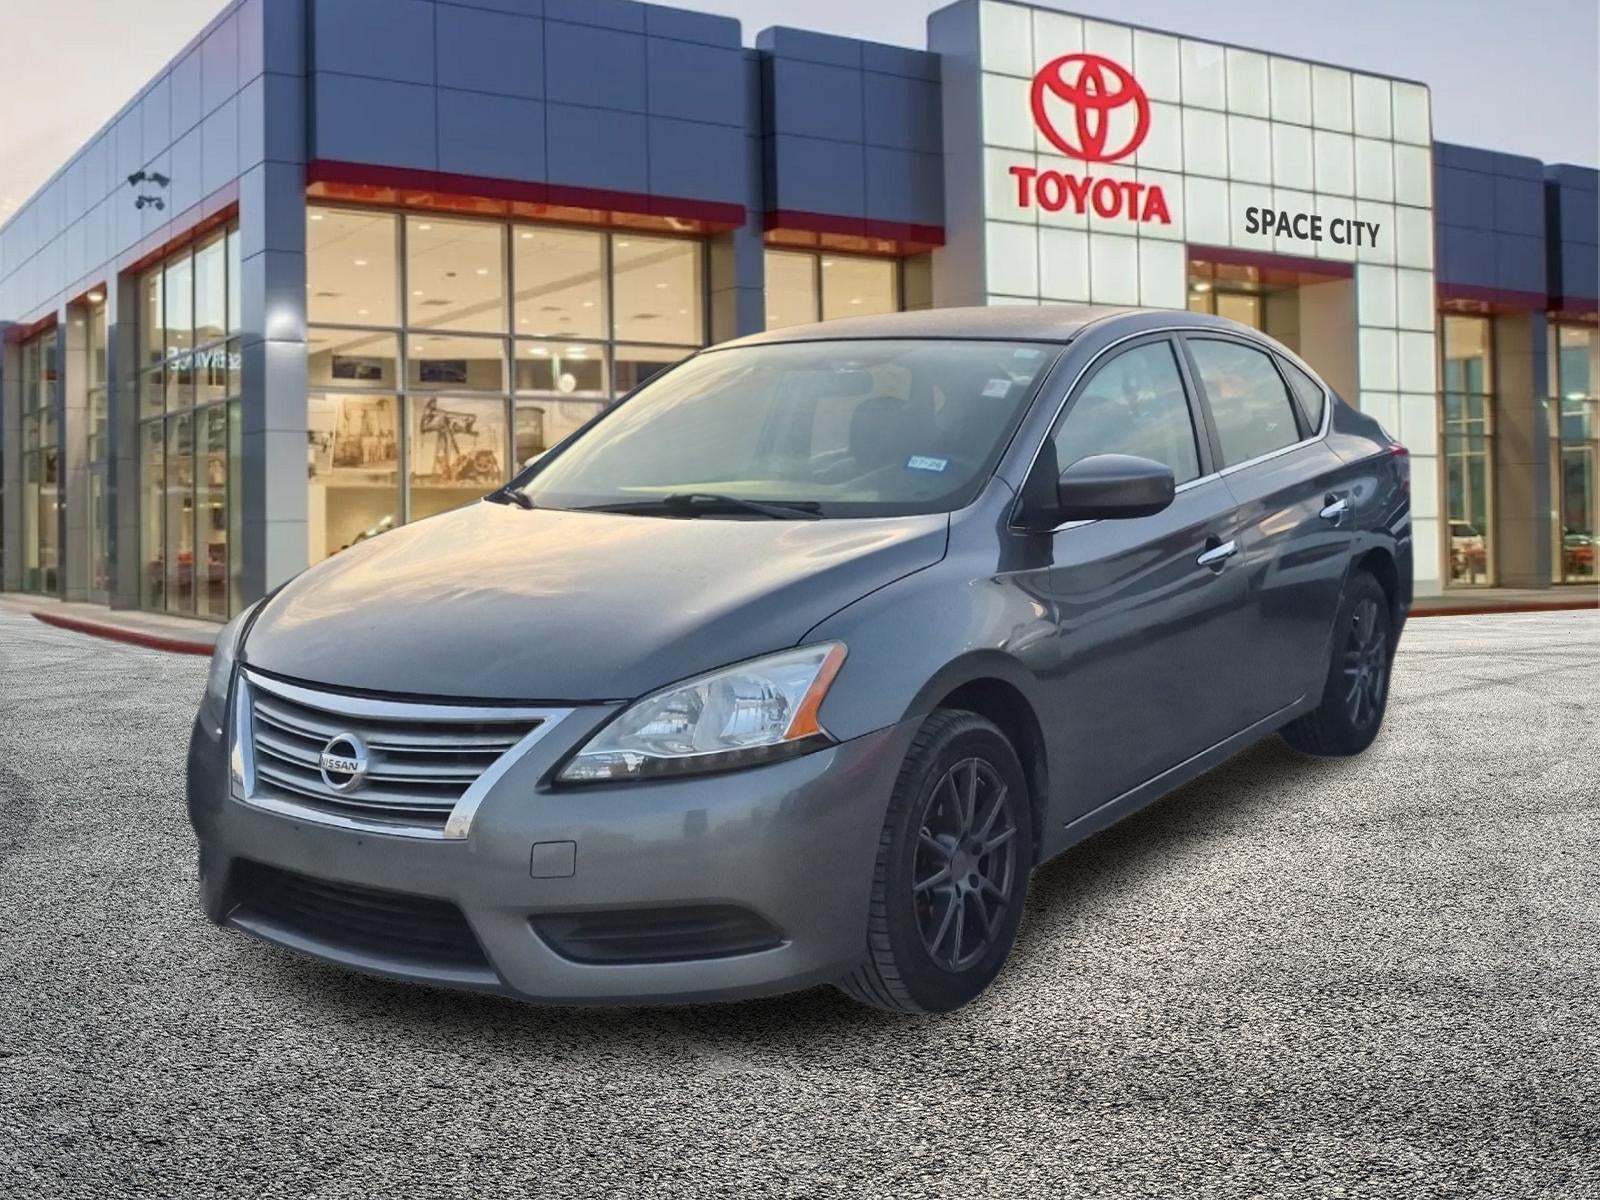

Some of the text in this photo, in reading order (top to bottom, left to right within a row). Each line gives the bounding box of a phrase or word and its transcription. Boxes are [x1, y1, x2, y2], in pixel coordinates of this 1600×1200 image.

[1009, 165, 1171, 224] TOYOTA
[1245, 206, 1381, 248] SPACE CITY
[322, 757, 359, 771] NISSAN
